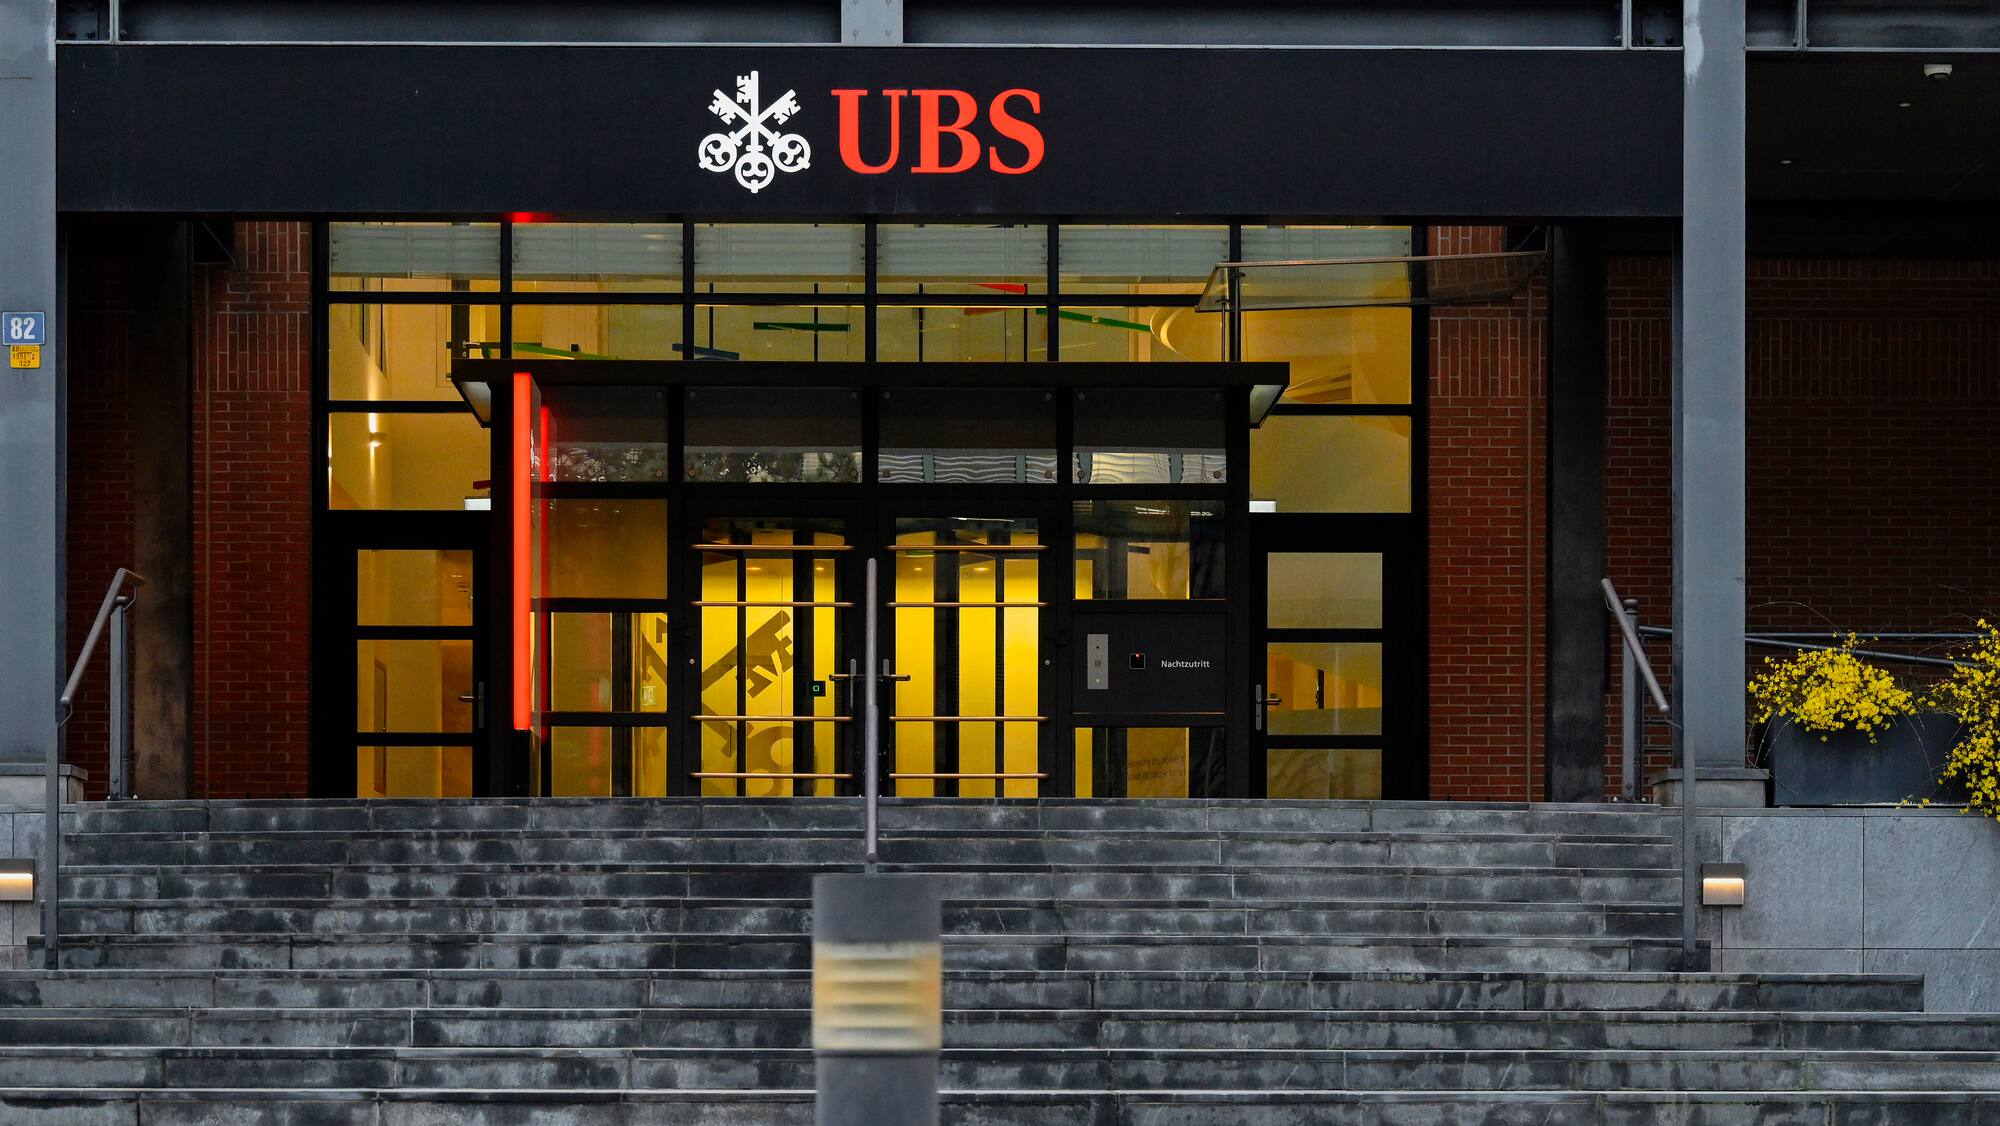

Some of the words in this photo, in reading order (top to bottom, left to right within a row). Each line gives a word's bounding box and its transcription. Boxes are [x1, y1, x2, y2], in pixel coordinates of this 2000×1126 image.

[831, 88, 1045, 174] UBS
[10, 317, 36, 340] 82
[1161, 659, 1210, 668] Nachtzutritt
